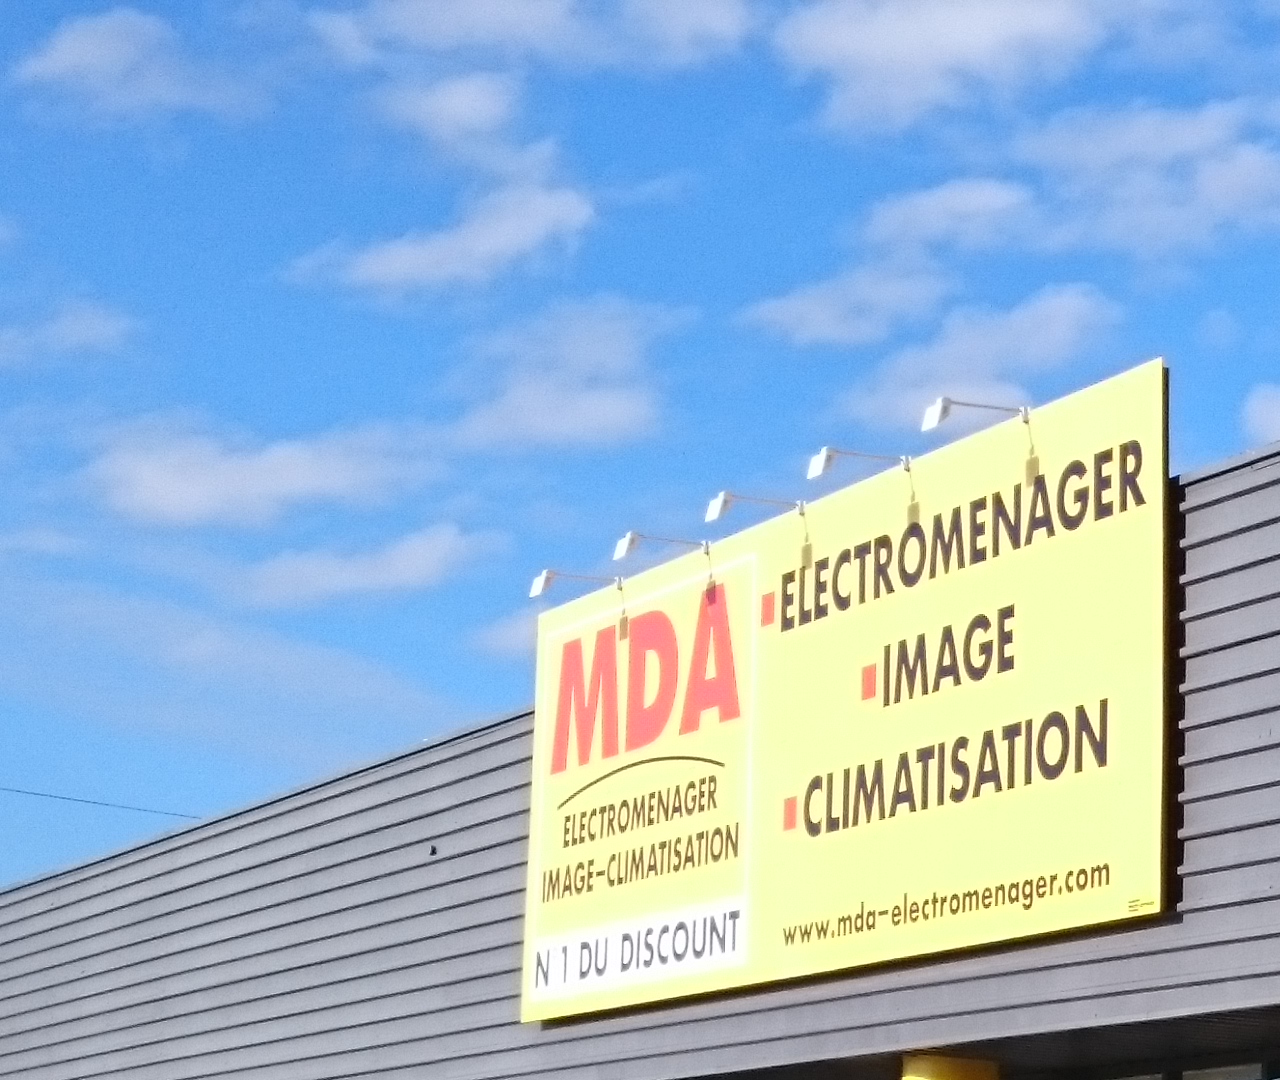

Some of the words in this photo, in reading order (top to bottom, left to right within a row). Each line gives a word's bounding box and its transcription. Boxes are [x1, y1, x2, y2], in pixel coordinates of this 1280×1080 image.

[780, 440, 1147, 633] ELECTROMENAGER
[549, 580, 741, 775] MDA
[882, 604, 1016, 707] IMAGE
[562, 774, 718, 849] ELECTROMENAGER
[802, 698, 1109, 838] CLIMATISATION
[541, 821, 740, 904] IMAGE-CLIMATISATION
[782, 862, 1111, 946] www.mda-electromenager.com
[579, 936, 609, 981] DU
[620, 910, 741, 974] DISCOUNT
